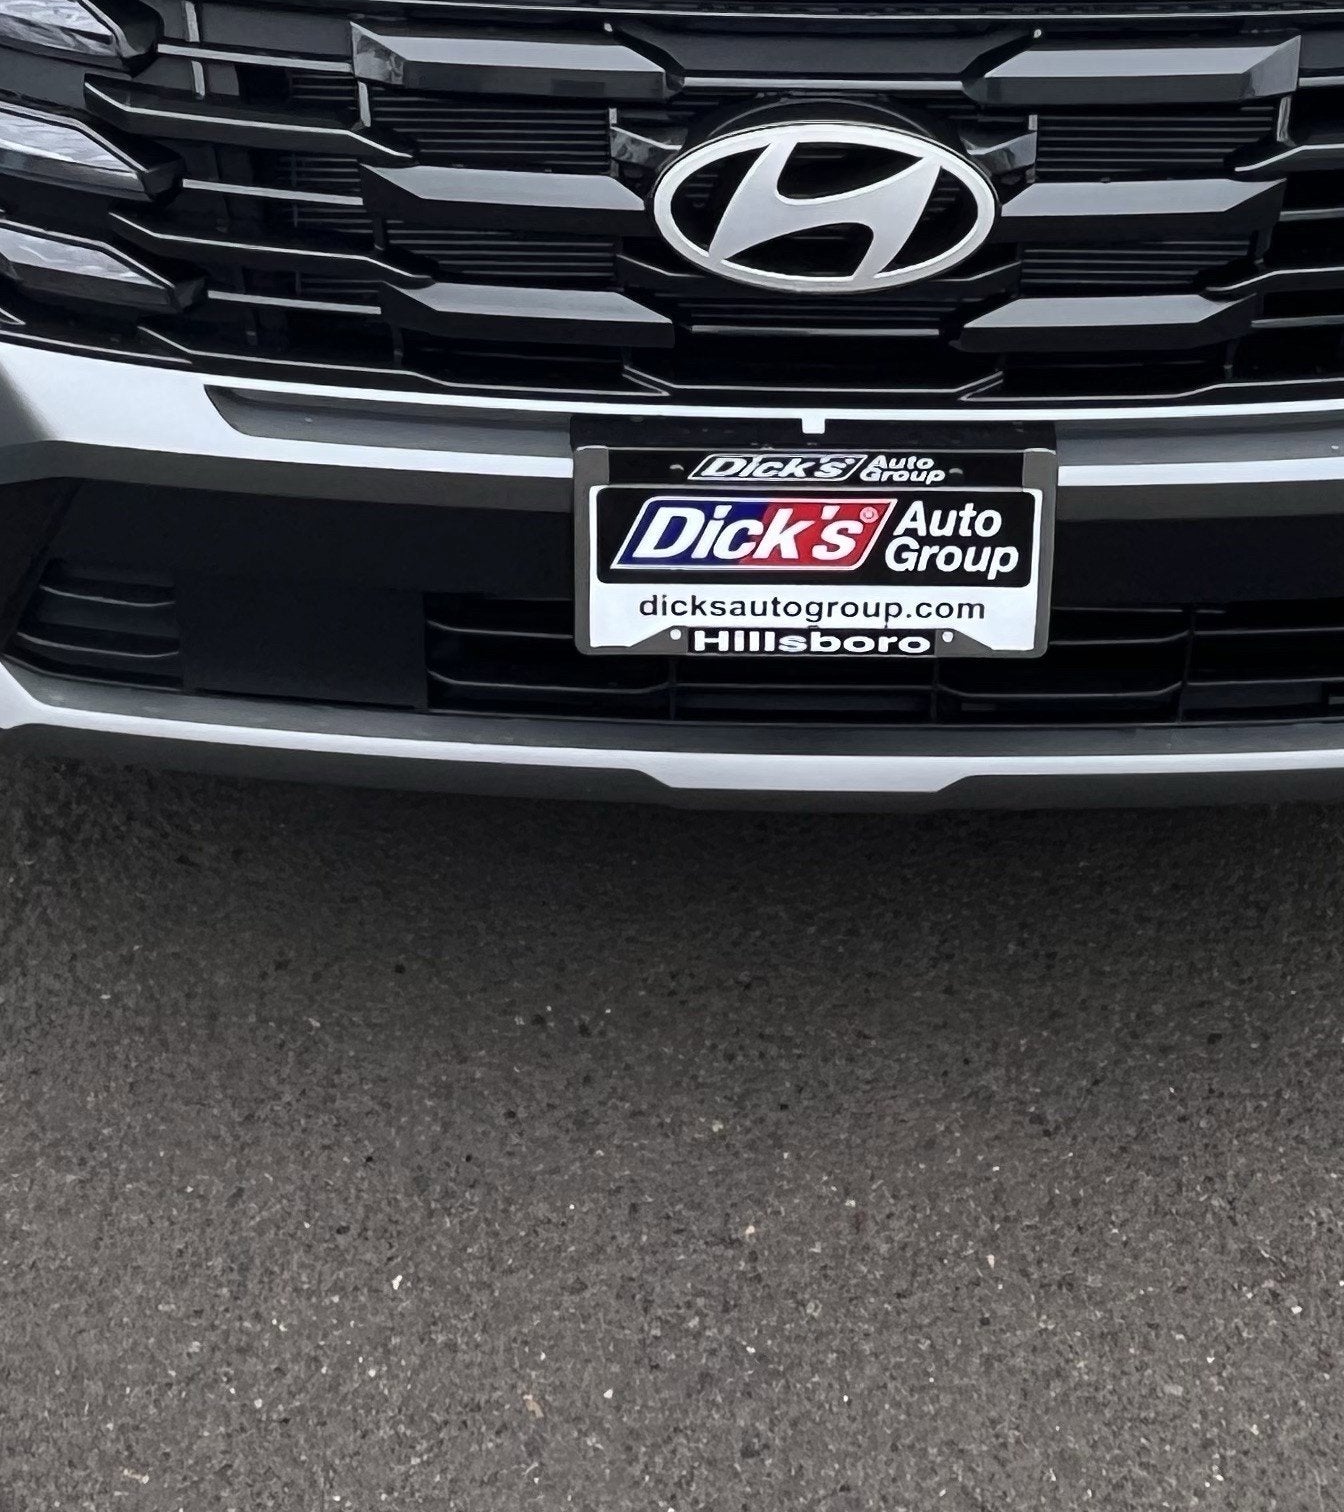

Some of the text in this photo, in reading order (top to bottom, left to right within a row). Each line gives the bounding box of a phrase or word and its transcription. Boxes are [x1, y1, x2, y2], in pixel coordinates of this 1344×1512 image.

[859, 466, 946, 485] Group
[871, 455, 934, 470] Auto
[632, 501, 1002, 561] Dick's Auto
[884, 537, 1019, 580] Group
[639, 595, 985, 623] dicksautogroup.com
[693, 630, 931, 654] Hillsboro
